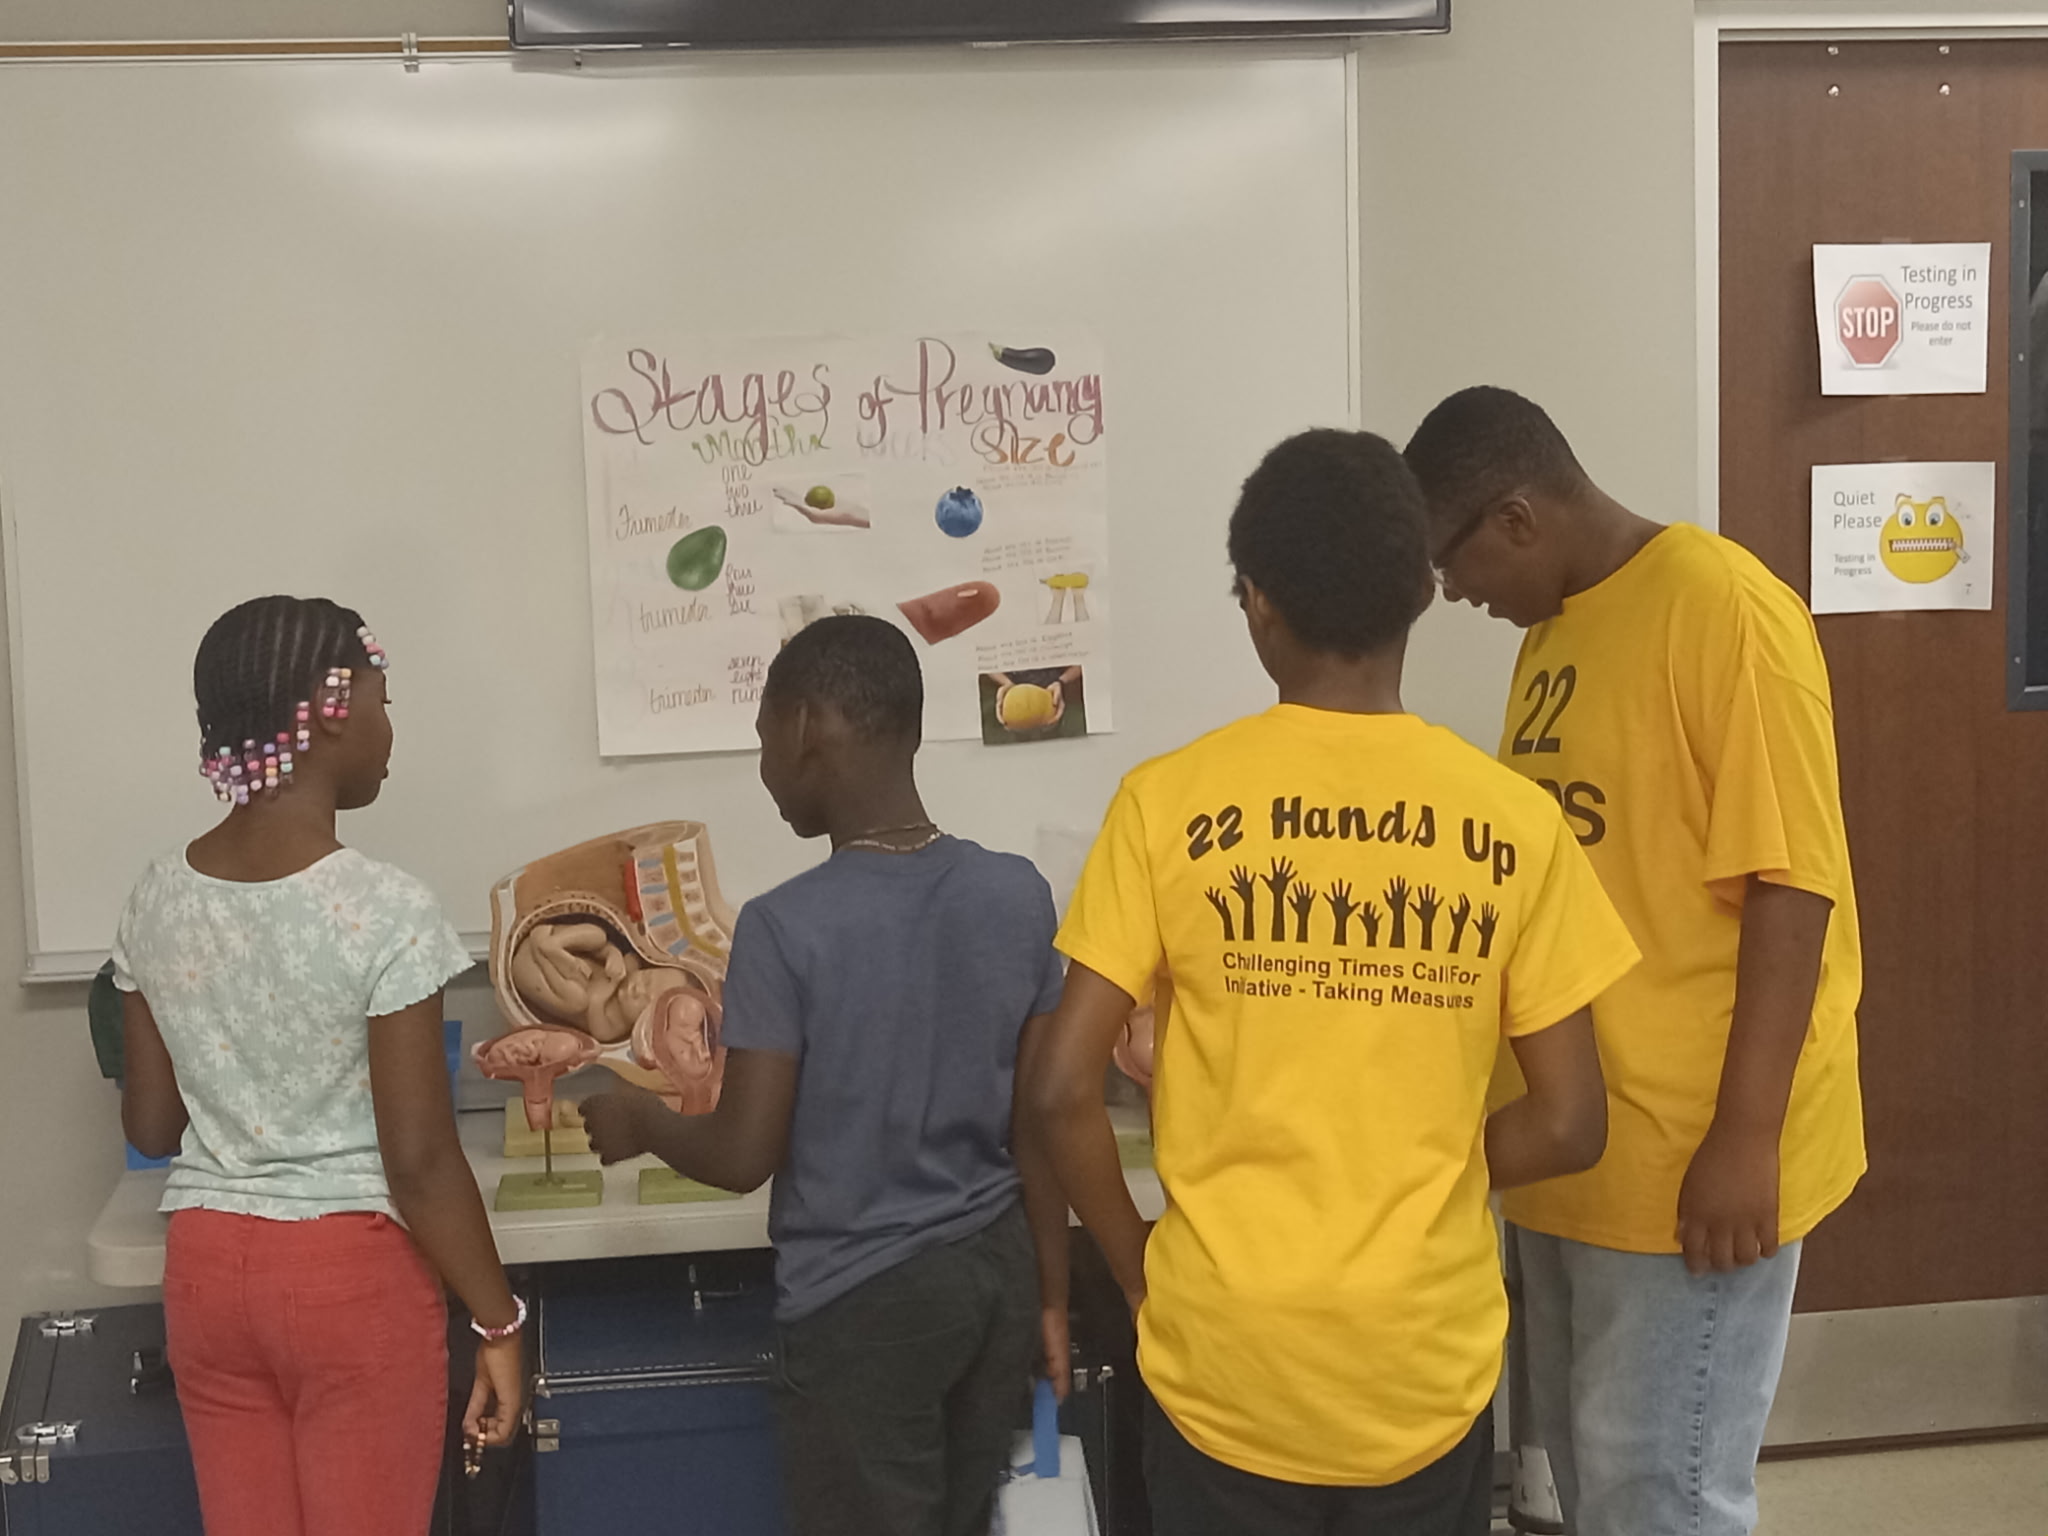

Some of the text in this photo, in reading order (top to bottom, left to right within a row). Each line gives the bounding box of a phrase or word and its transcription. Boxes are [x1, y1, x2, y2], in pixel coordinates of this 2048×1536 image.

[1901, 264, 1977, 287] Testing in
[1904, 292, 1973, 314] Progress
[1842, 306, 1895, 339] STOP
[1911, 320, 1972, 332] Please do not
[1929, 336, 1953, 346] enter
[591, 348, 831, 467] Stages
[857, 375, 893, 449] of
[1833, 491, 1875, 507] Quiet
[1833, 513, 1882, 529] Please
[1834, 553, 1876, 564] Testing in
[1834, 566, 1872, 578] Progress
[1512, 664, 1577, 756] 22
[1186, 796, 1516, 886] 22 Hands Up
[1338, 957, 1404, 979] Times
[1312, 980, 1383, 1007] Taking
[1391, 985, 1474, 1009] Measues
